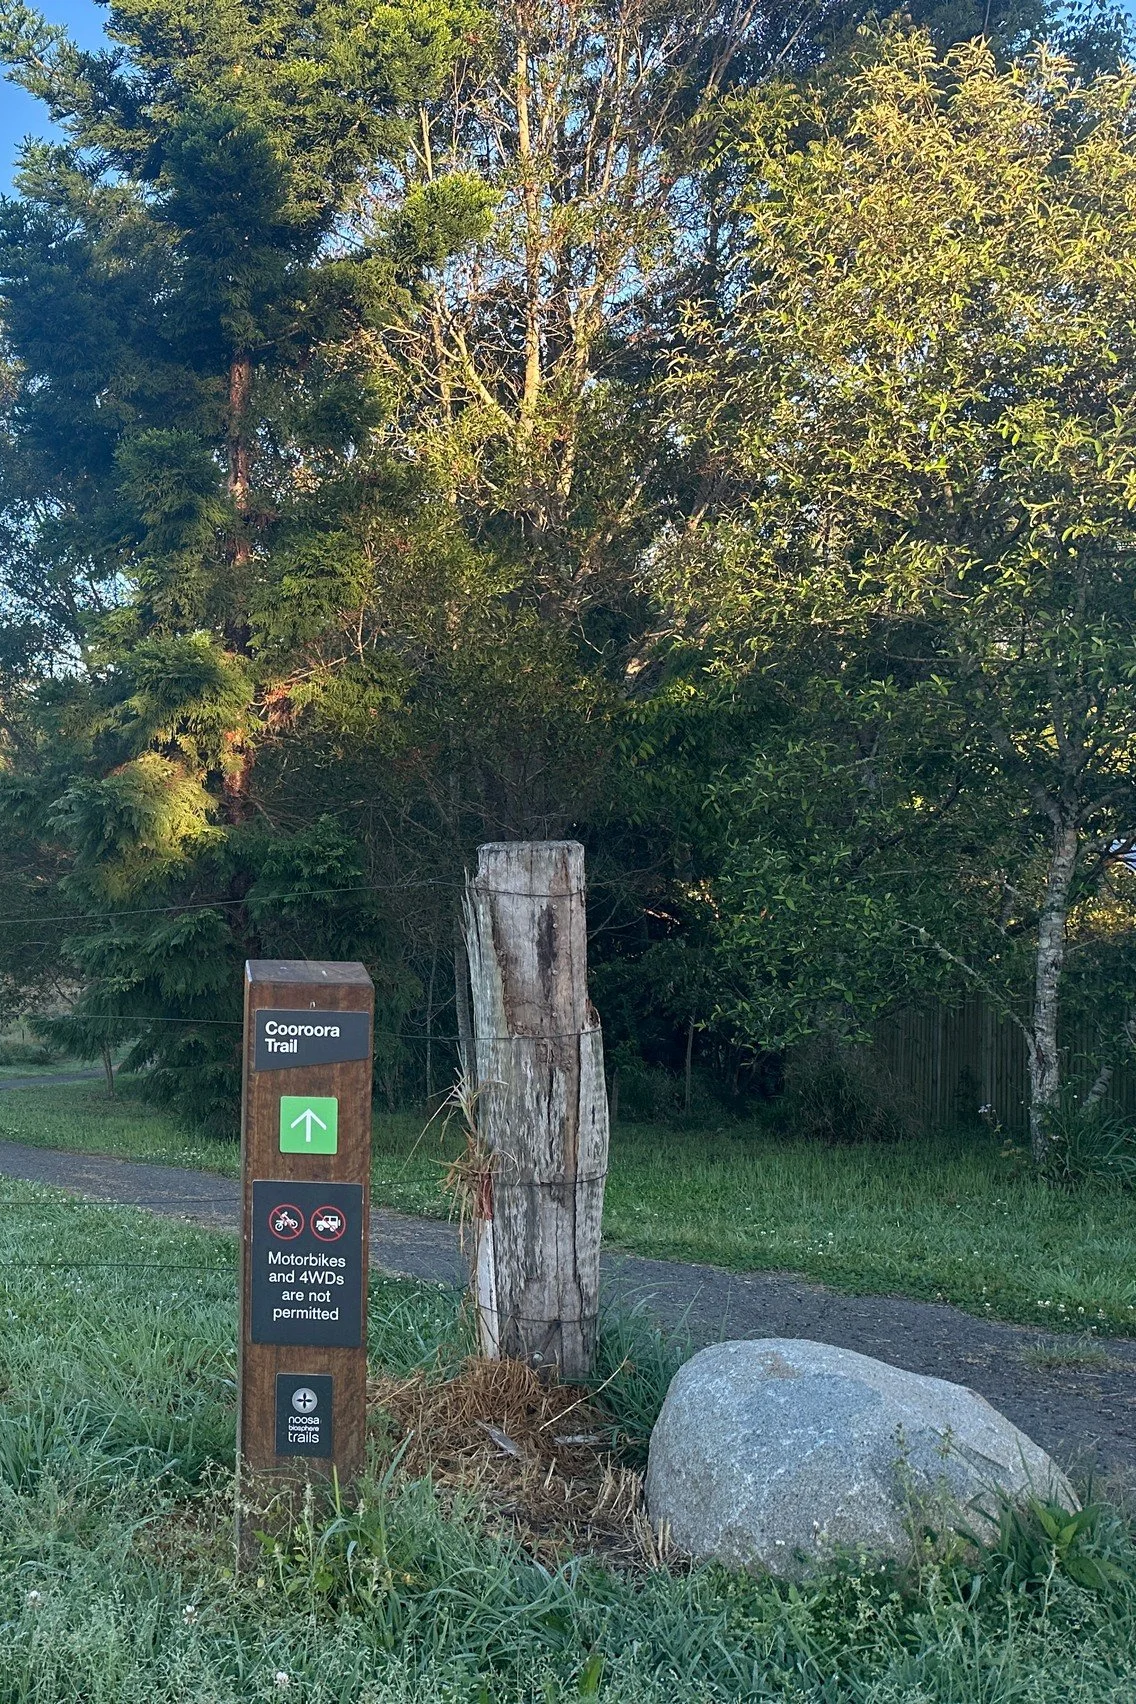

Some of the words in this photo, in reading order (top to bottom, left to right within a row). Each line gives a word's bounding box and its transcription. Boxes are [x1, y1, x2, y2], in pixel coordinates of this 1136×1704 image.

[265, 1020, 340, 1037] Cooroora
[265, 1038, 298, 1053] Trail
[268, 1251, 346, 1267] Motorbikes
[269, 1270, 295, 1283] and
[299, 1270, 344, 1285] 4WDs
[281, 1290, 304, 1301] are
[308, 1290, 331, 1302] not
[273, 1306, 339, 1321] permitted
[288, 1416, 320, 1425] noosa
[288, 1424, 320, 1432] biosphere
[288, 1431, 320, 1443] trails
